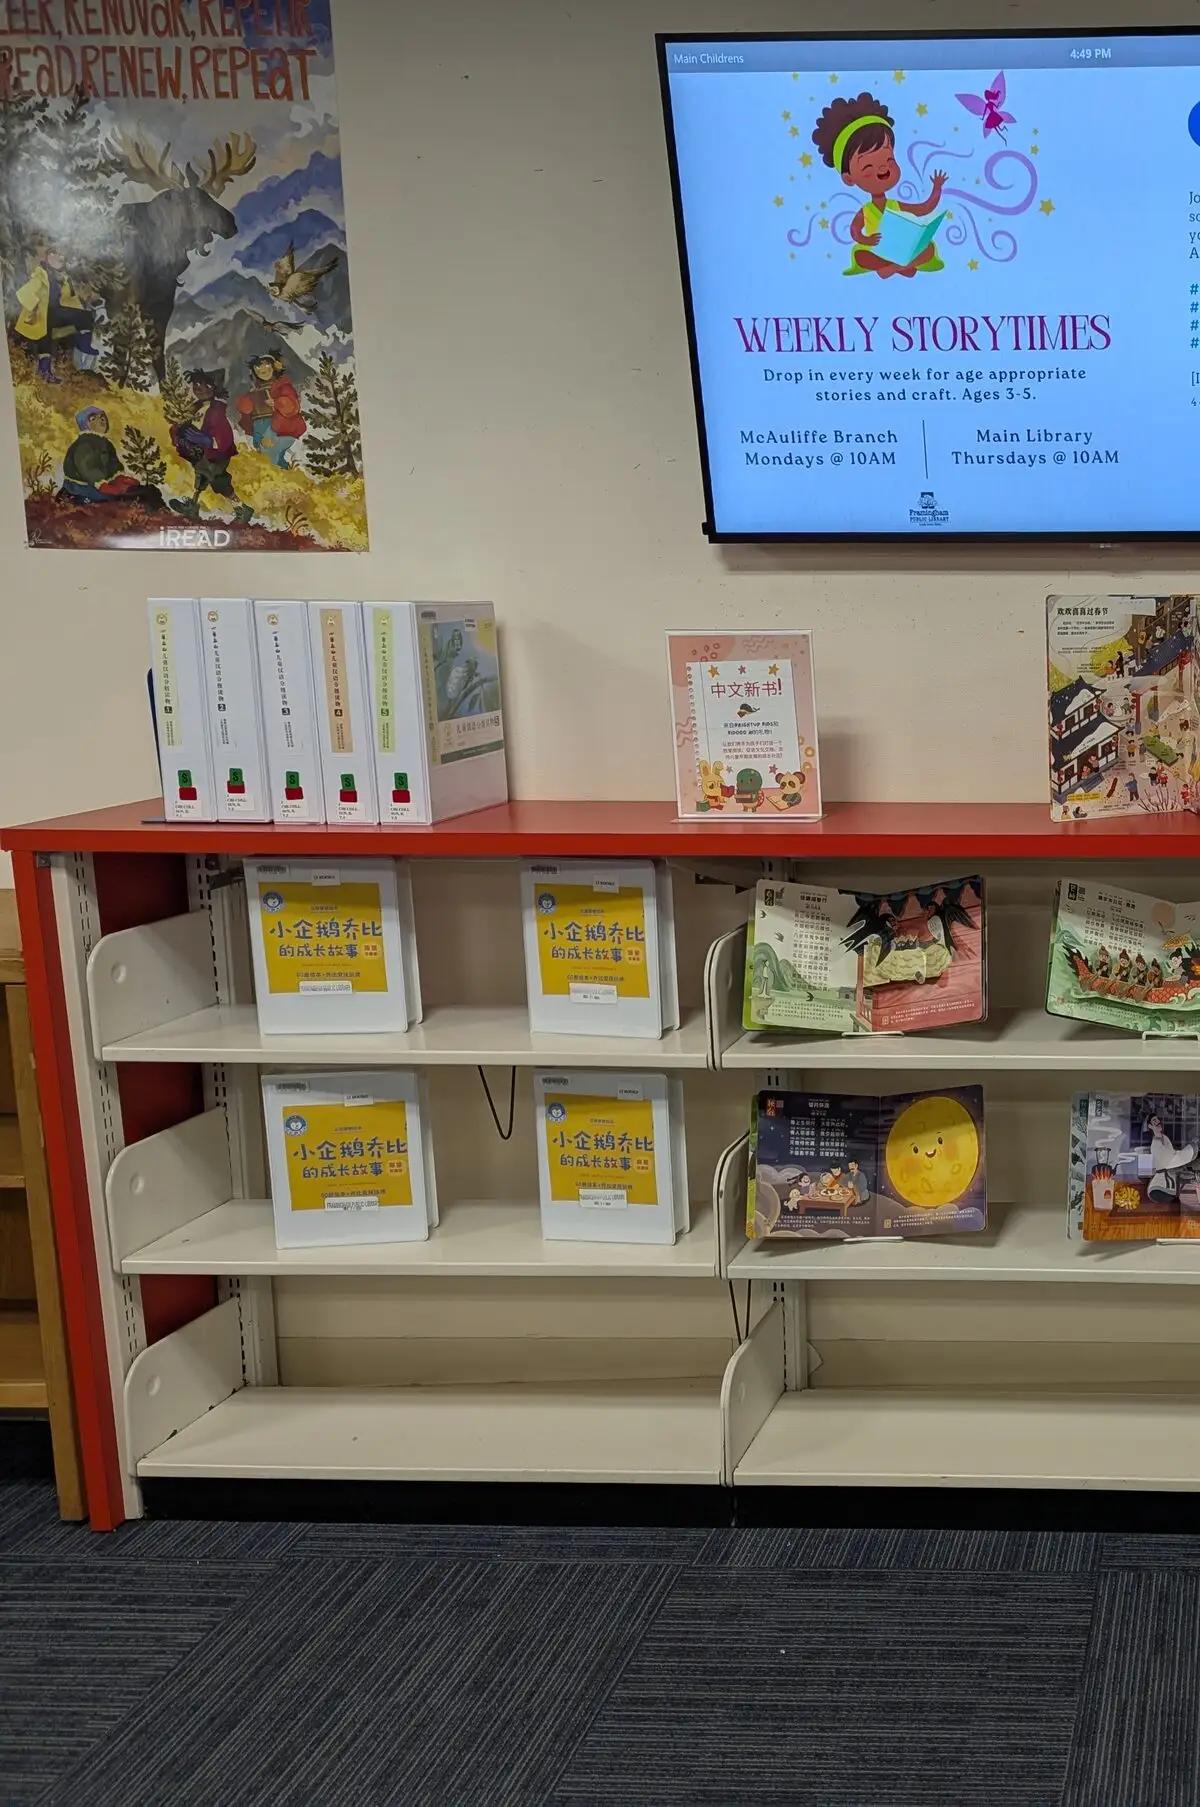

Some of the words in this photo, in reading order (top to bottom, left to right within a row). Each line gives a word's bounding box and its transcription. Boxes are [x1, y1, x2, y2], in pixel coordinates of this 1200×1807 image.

[674, 53, 698, 64] Main
[700, 52, 744, 64] Childrens
[1070, 48, 1092, 59] 4:49
[1095, 48, 1111, 59] PM
[734, 316, 879, 353] WEEKLY
[892, 314, 1111, 352] STORYTIMES
[764, 368, 803, 384] Drop
[809, 369, 824, 381] in
[829, 370, 874, 383] every
[879, 367, 920, 380] week
[926, 367, 949, 380] for
[955, 369, 984, 383] age
[989, 367, 1086, 383] appropriate
[816, 389, 871, 401] stories
[877, 388, 906, 400] and
[912, 388, 956, 400] craft.
[962, 388, 999, 403] Ages
[1006, 387, 1036, 400] 3-5.
[1191, 398, 1197, 406] 4
[740, 430, 827, 444] McAuliffe
[834, 429, 898, 443] Branch
[976, 429, 1020, 443] Main
[1027, 428, 1092, 445] Library
[745, 452, 824, 468] Mondays
[830, 452, 844, 466] @
[850, 452, 896, 465] 10AM
[952, 451, 1046, 466] Thursdays
[1053, 452, 1066, 465] @
[1072, 451, 1119, 464] 10AM
[160, 526, 231, 546] iREAD
[181, 772, 188, 784] S
[232, 772, 239, 782] S
[289, 774, 296, 785] S
[345, 776, 352, 787] S
[398, 775, 405, 786] S
[270, 917, 382, 941] 小企鹅乔比
[544, 921, 645, 945] 小企鹅乔比
[279, 943, 360, 959] 的成长故事
[552, 945, 623, 963] 的成长故事
[293, 1136, 407, 1160] 小企鹅乔比
[552, 1131, 654, 1154] 小企鹅乔比
[560, 1153, 633, 1171] 的成长故事
[302, 1162, 385, 1179] 的成长故事
